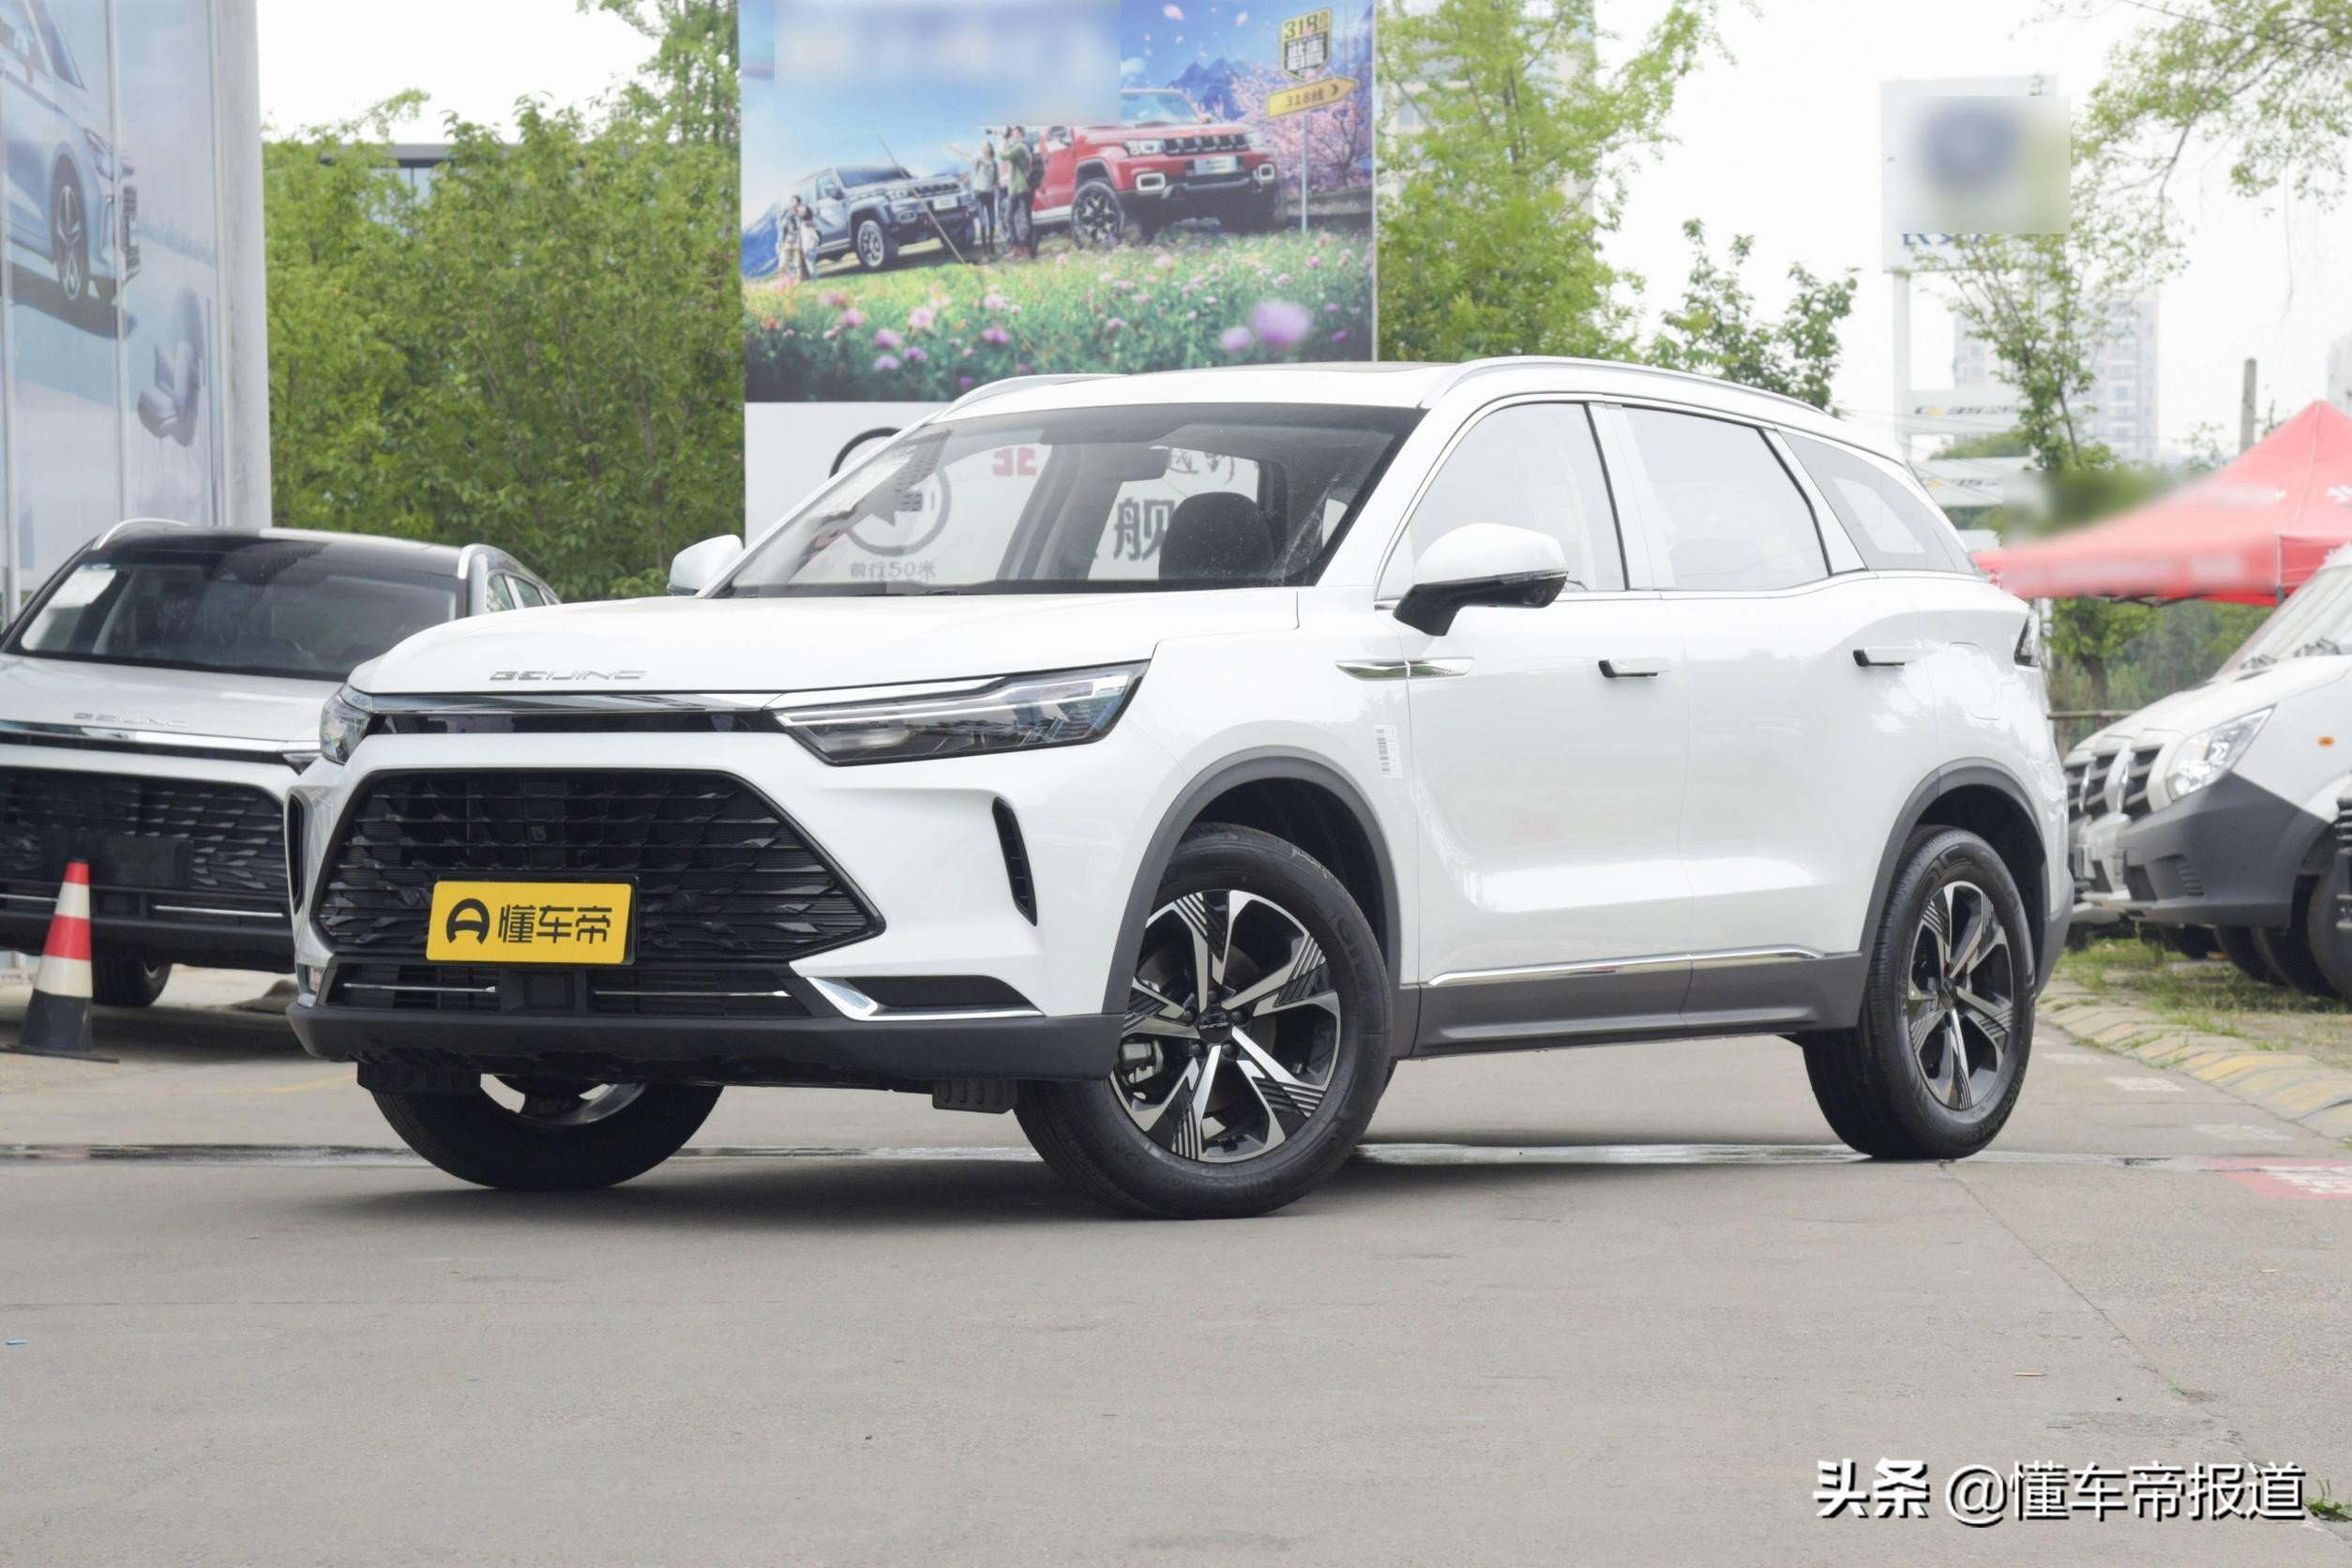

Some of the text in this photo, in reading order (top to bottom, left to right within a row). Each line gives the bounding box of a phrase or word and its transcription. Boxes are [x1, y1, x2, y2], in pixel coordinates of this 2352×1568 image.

[490, 670, 647, 682] BEIJING
[498, 905, 612, 944] 懂车帝
